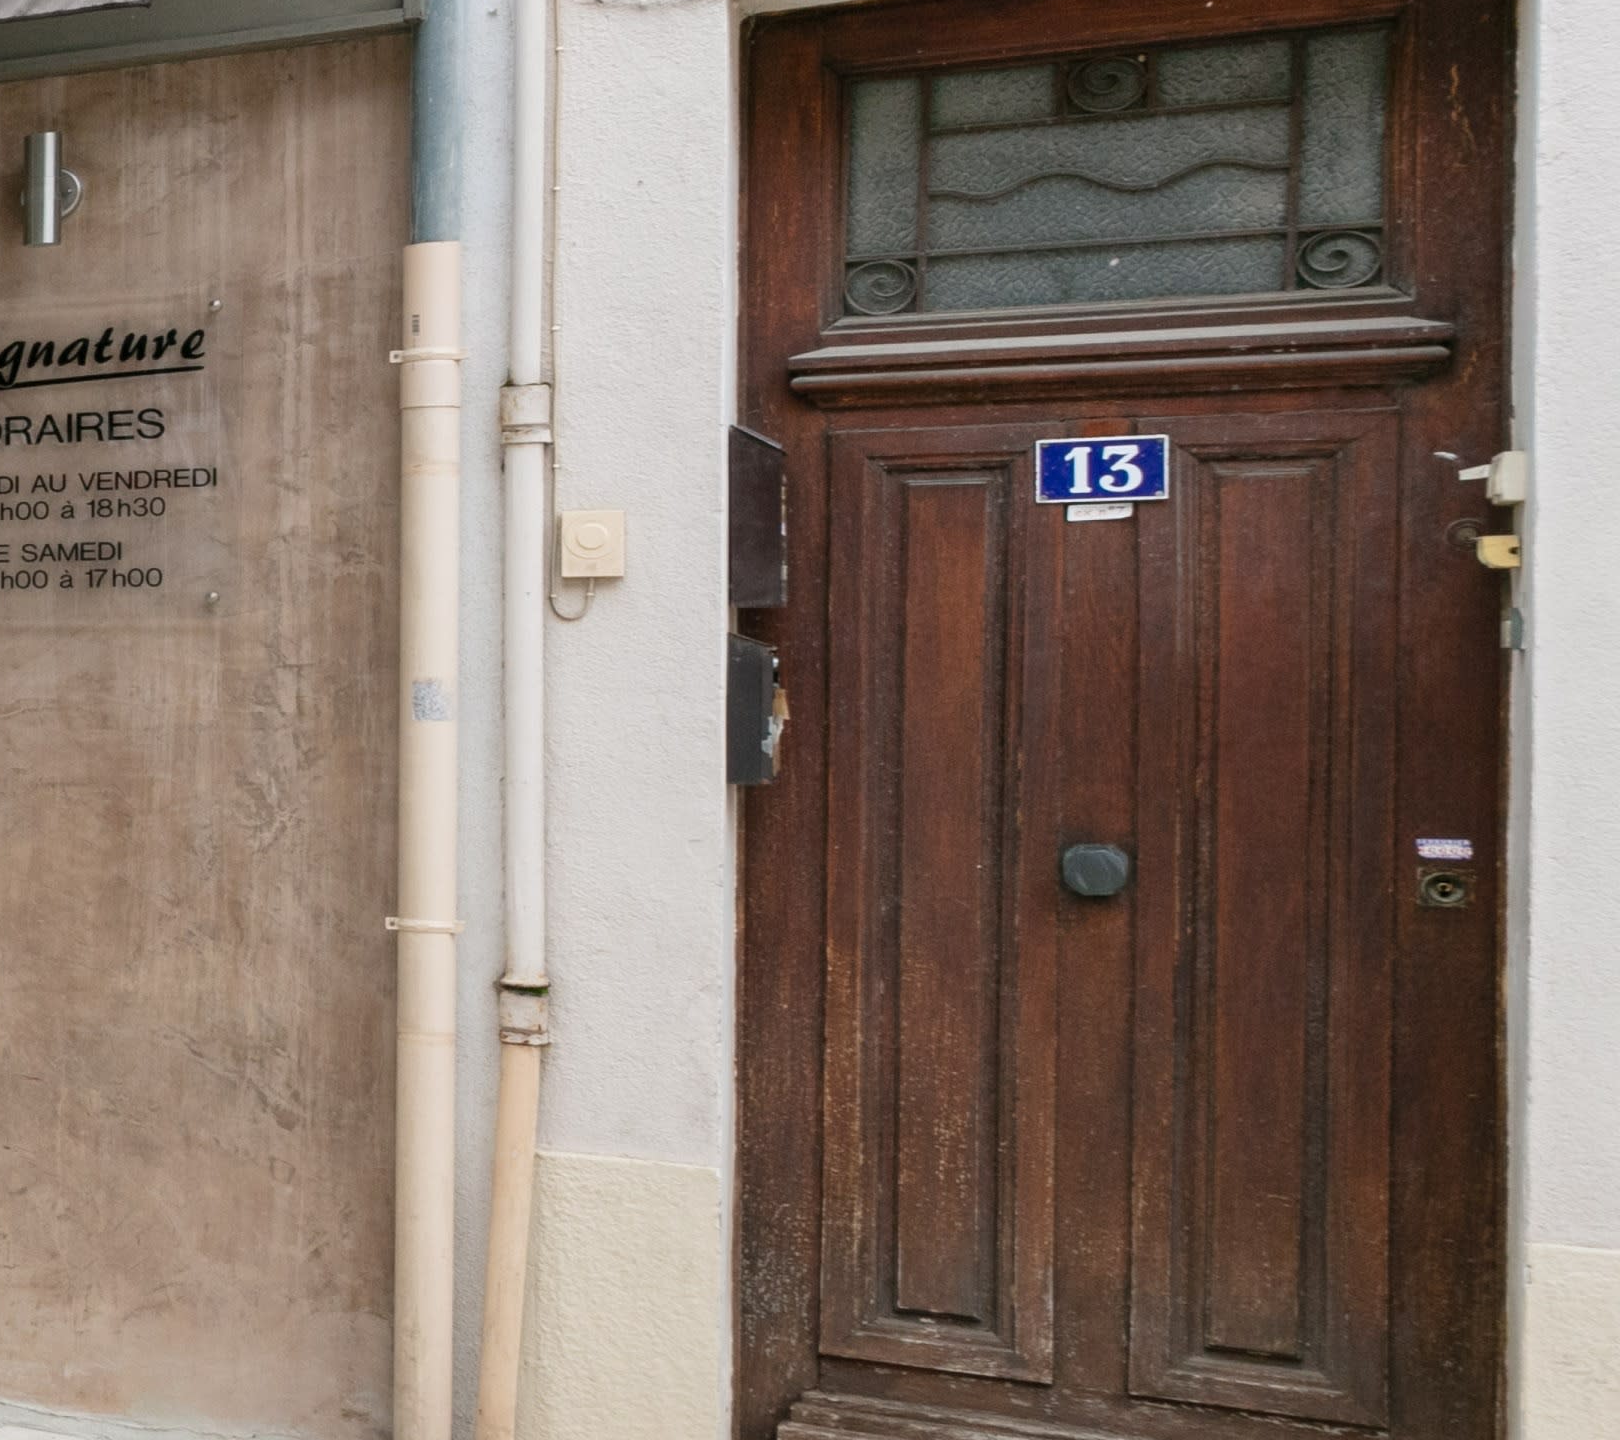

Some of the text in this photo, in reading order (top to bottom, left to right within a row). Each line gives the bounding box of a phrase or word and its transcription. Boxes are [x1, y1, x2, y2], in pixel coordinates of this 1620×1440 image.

[1064, 444, 1143, 493] 13
[31, 474, 67, 494] AU
[78, 468, 217, 492] VENDREDI
[60, 501, 75, 520] à
[90, 497, 166, 518] 18h30
[21, 541, 122, 562] SAMEDI
[59, 570, 73, 589] à
[87, 568, 163, 588] 17h00
